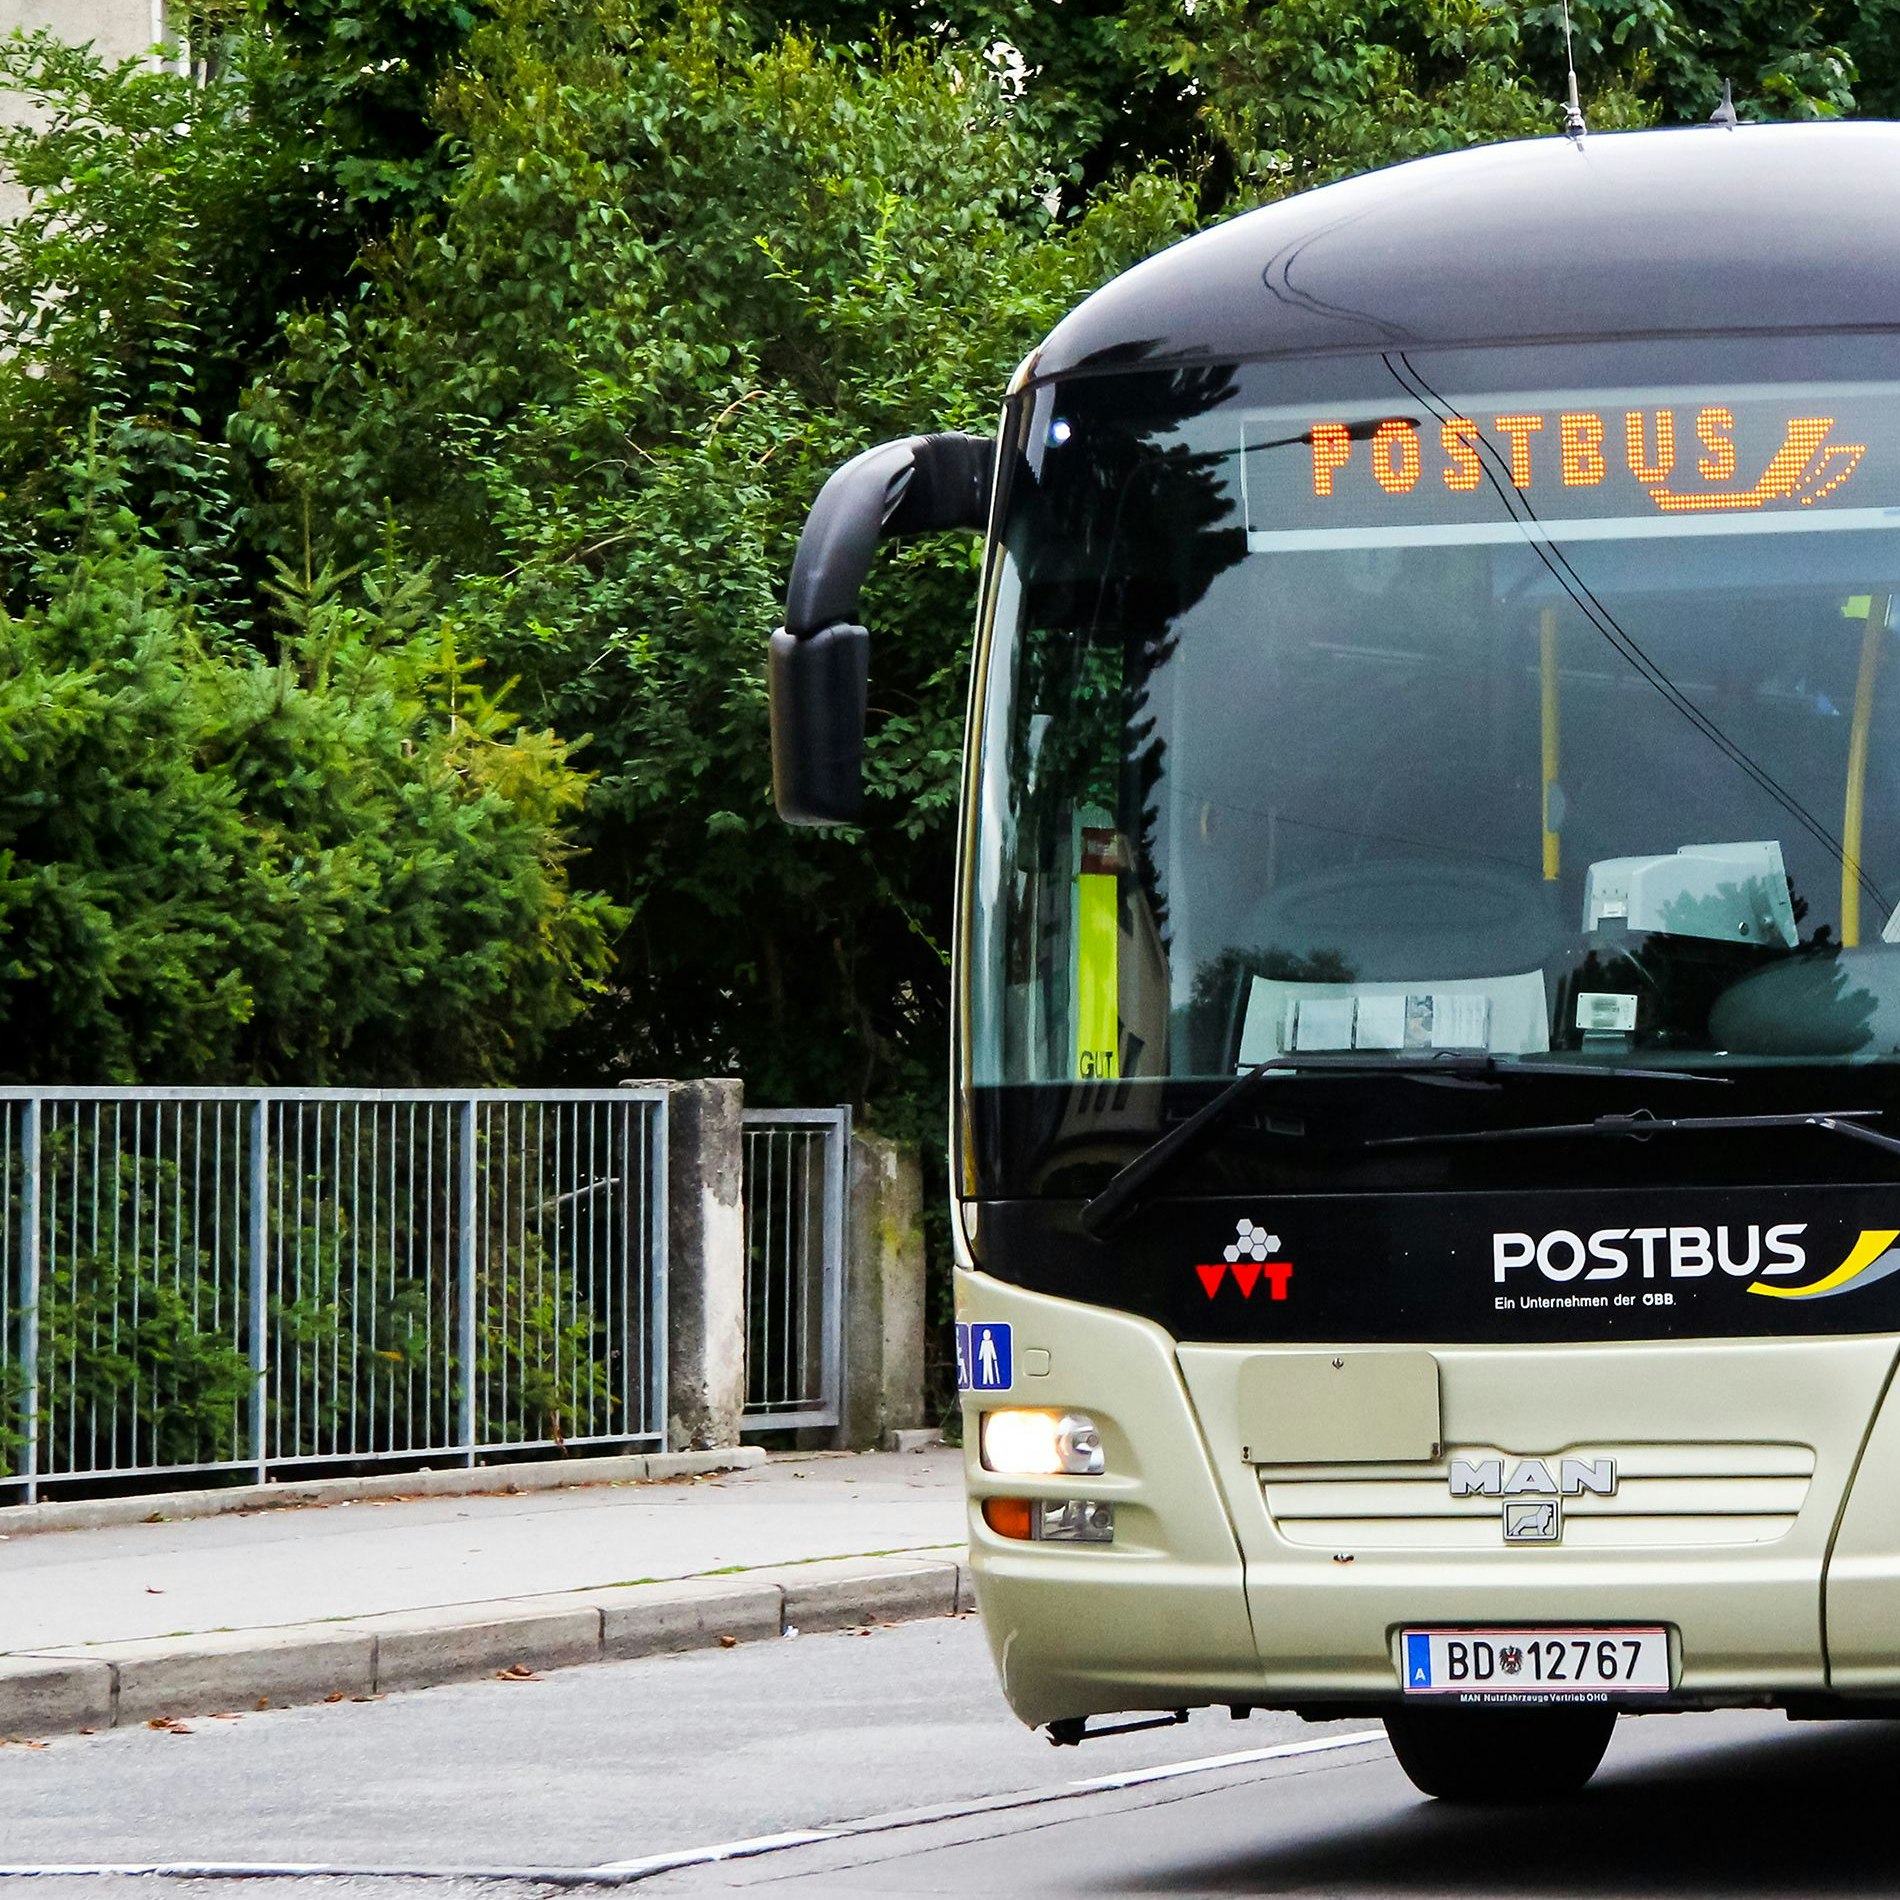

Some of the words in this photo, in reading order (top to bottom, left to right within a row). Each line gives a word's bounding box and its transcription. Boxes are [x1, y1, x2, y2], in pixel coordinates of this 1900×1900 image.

[1311, 408, 1737, 496] POSTBUS
[1493, 1223, 1808, 1283] POSTBUS
[1195, 1262, 1293, 1301] VVT
[1494, 1296, 1516, 1310] Ein
[1520, 1294, 1609, 1309] Unternehmen
[1613, 1293, 1637, 1307] der
[1449, 1459, 1617, 1496] MAN
[1414, 1668, 1426, 1680] A
[1447, 1641, 1494, 1680] BD
[1527, 1640, 1642, 1680] 12767
[1460, 1693, 1481, 1702] MAN
[1483, 1693, 1549, 1703] Nutzfahrzeuge
[1550, 1693, 1586, 1702] Vertrieb
[1586, 1693, 1608, 1702] OHG
